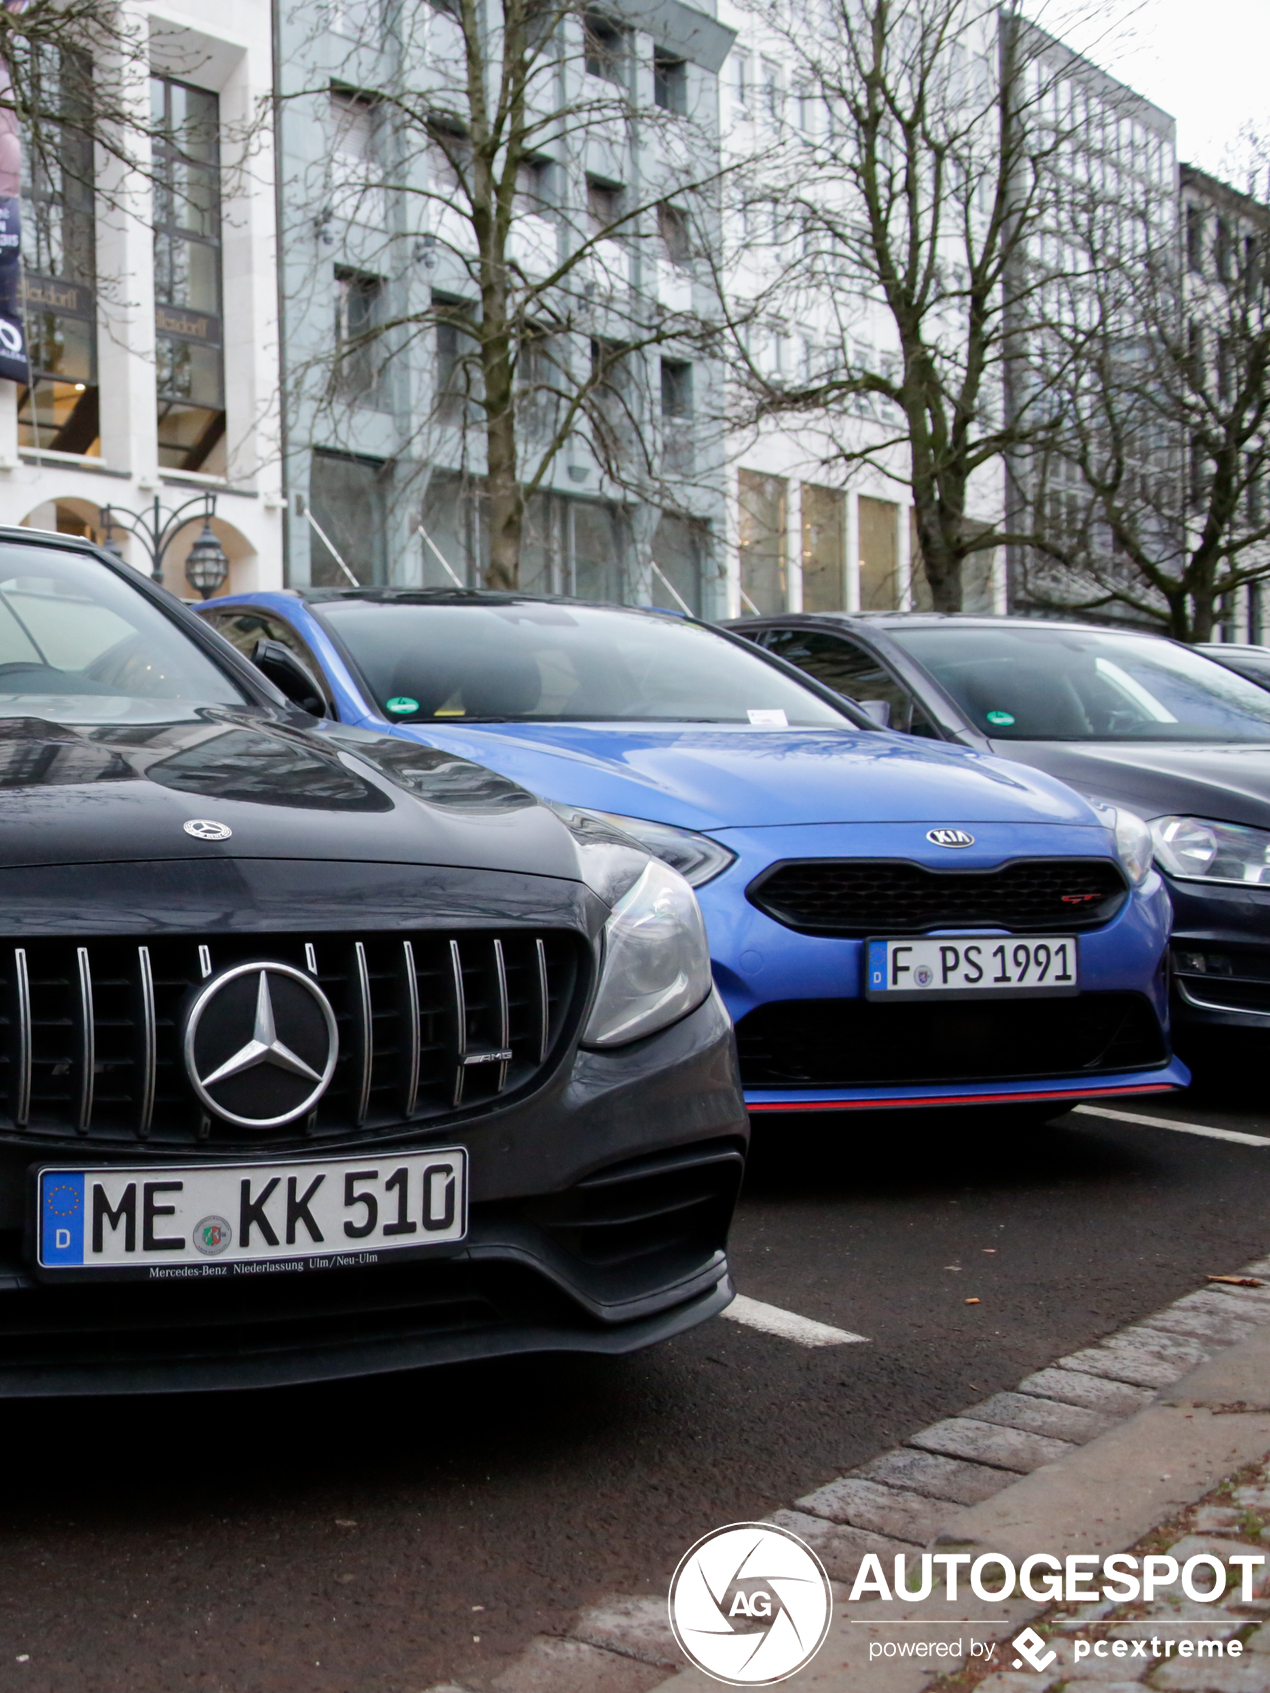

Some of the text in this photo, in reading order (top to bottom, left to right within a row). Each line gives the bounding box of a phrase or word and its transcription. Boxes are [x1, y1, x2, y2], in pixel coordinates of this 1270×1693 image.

[932, 830, 971, 843] KIA
[892, 946, 913, 985] F
[939, 945, 983, 984] PS
[992, 943, 1072, 983] 1991
[873, 971, 882, 984] D
[480, 1051, 512, 1062] AMG
[92, 1180, 186, 1252] ME
[239, 1174, 326, 1247] KK
[343, 1163, 456, 1239] 510
[55, 1229, 71, 1250] D
[149, 1253, 378, 1279] Mercedes-Benz Niederlassung Ulm/Neu-Ulm
